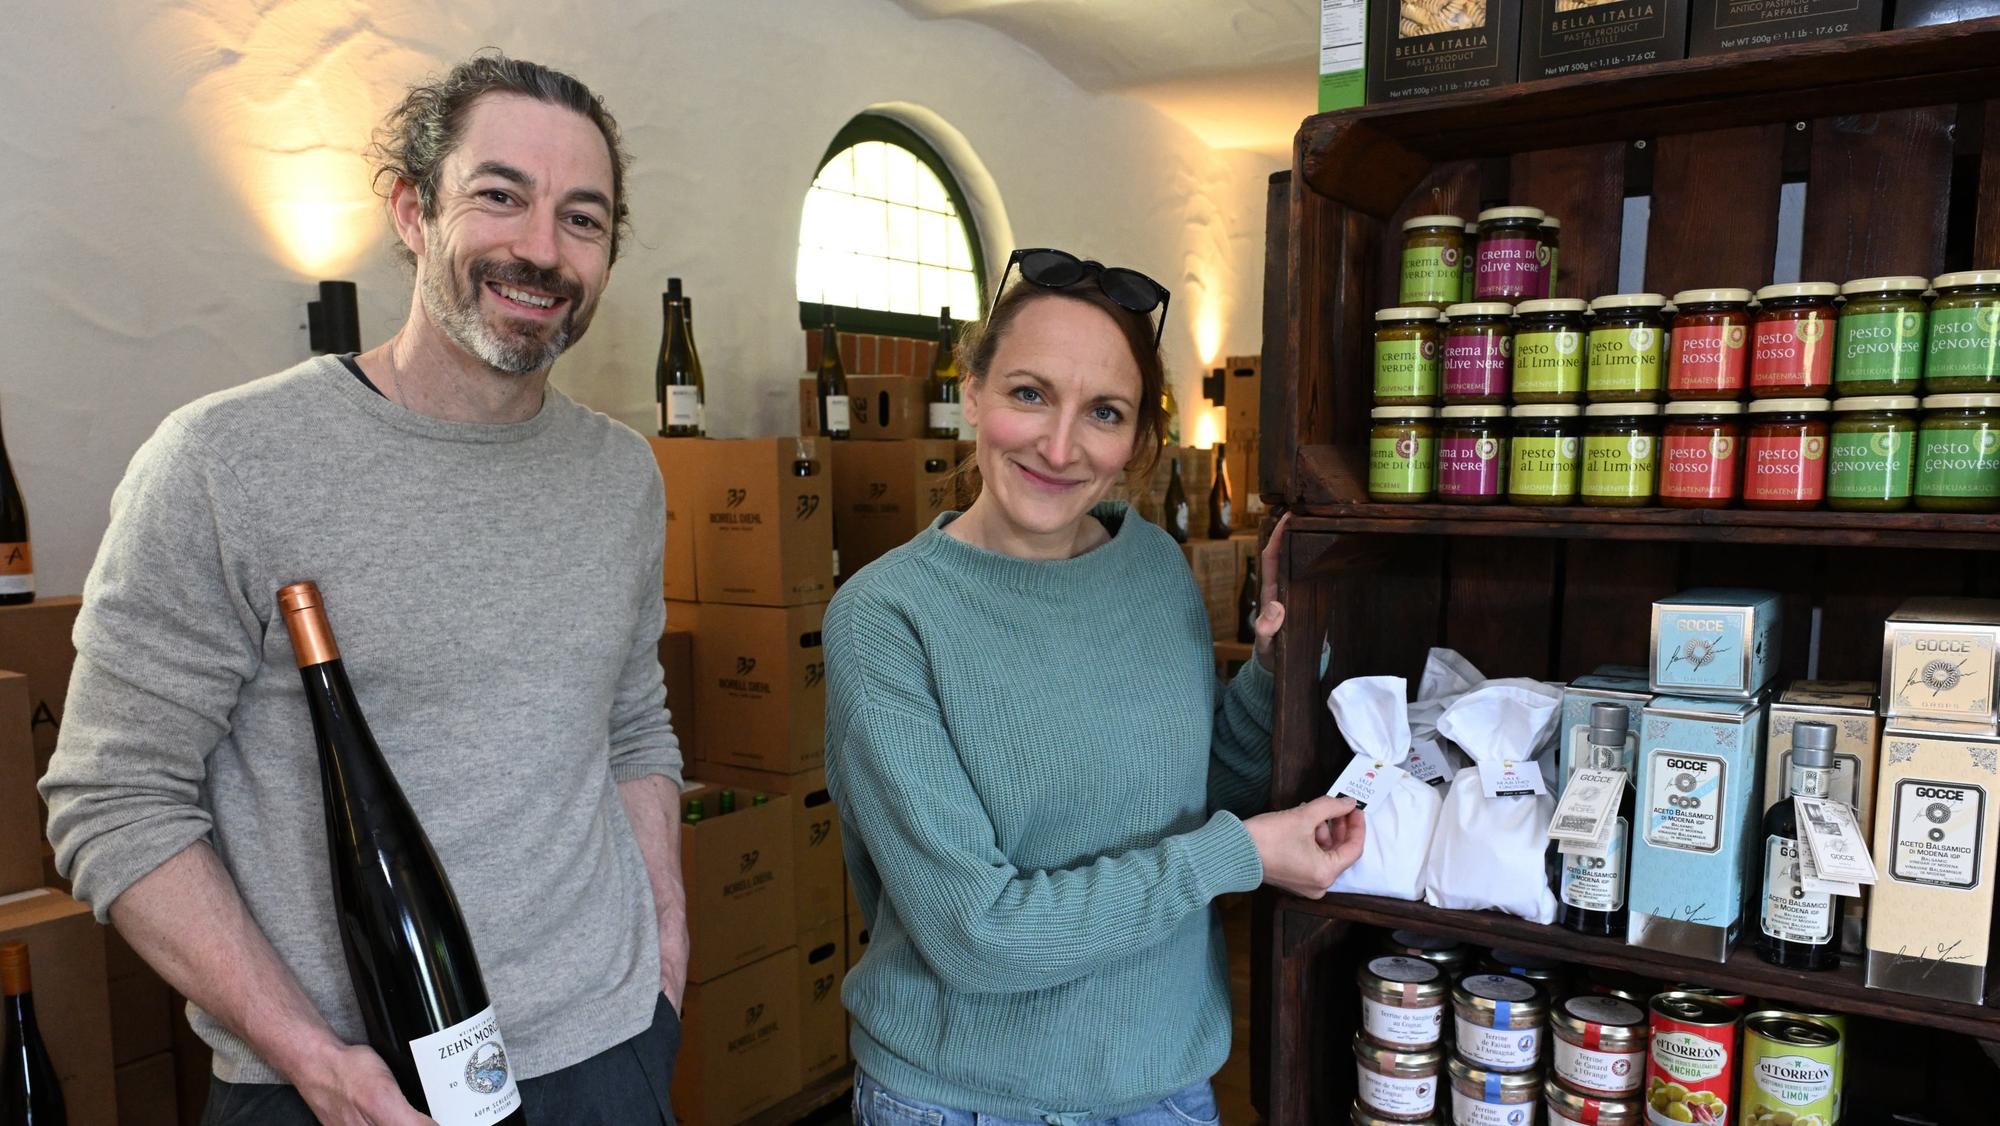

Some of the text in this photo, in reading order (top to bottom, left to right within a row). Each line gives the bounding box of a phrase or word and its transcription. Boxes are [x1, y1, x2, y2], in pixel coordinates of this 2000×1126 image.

[1730, 4, 1763, 15] ANTICO
[1761, 6, 1809, 19] FARFALLE
[1552, 5, 1654, 32] BELLA ITALIA
[1564, 23, 1639, 42] PASTA PRODUCT
[1721, 24, 1848, 48] Net WT 500g 1.1 Lb 17.6 OZ
[1395, 35, 1488, 57] BELLA ITALIA
[1406, 51, 1474, 68] PASTA PRODUCT
[1545, 50, 1656, 76] Net WT 500g 1.1 Lb 17.6 OZ
[1390, 90, 1400, 98] Net
[1400, 89, 1413, 97] WT
[1413, 86, 1430, 97] 500g
[1479, 79, 1490, 87] OZ
[1682, 353, 1722, 364] ROSSO
[1756, 348, 1795, 360] ROSSO
[1669, 463, 1709, 473] ROSSO
[1757, 464, 1800, 474] ROSSO
[1677, 619, 1724, 632] GOCCE
[1915, 639, 1971, 653] GOCCE
[1667, 758, 1708, 772] GOCCE
[1579, 774, 1614, 784] GOCCE
[1916, 787, 1964, 801] GOCCE
[1653, 807, 1714, 821] ACETO BALSAMICO
[1668, 815, 1695, 824] MODENA
[1900, 840, 1971, 854] ACETO BALSAMICO
[1917, 849, 1949, 858] MODENA
[1576, 875, 1601, 883] MODENA
[1582, 869, 1618, 878] BALSAMICO
[1769, 894, 1828, 909] ACETO BALSAMICO
[1780, 904, 1809, 914] MODENA
[1485, 1033, 1508, 1041] Terrine
[438, 1036, 472, 1060] ZEHN
[1574, 1058, 1608, 1071] de Canard
[1579, 1053, 1603, 1063] Terrine
[1669, 1064, 1702, 1077] ANCHOA
[1782, 1090, 1809, 1101] LIMÓN
[474, 1106, 491, 1117] AUFM
[1474, 1105, 1497, 1114] Terrine
